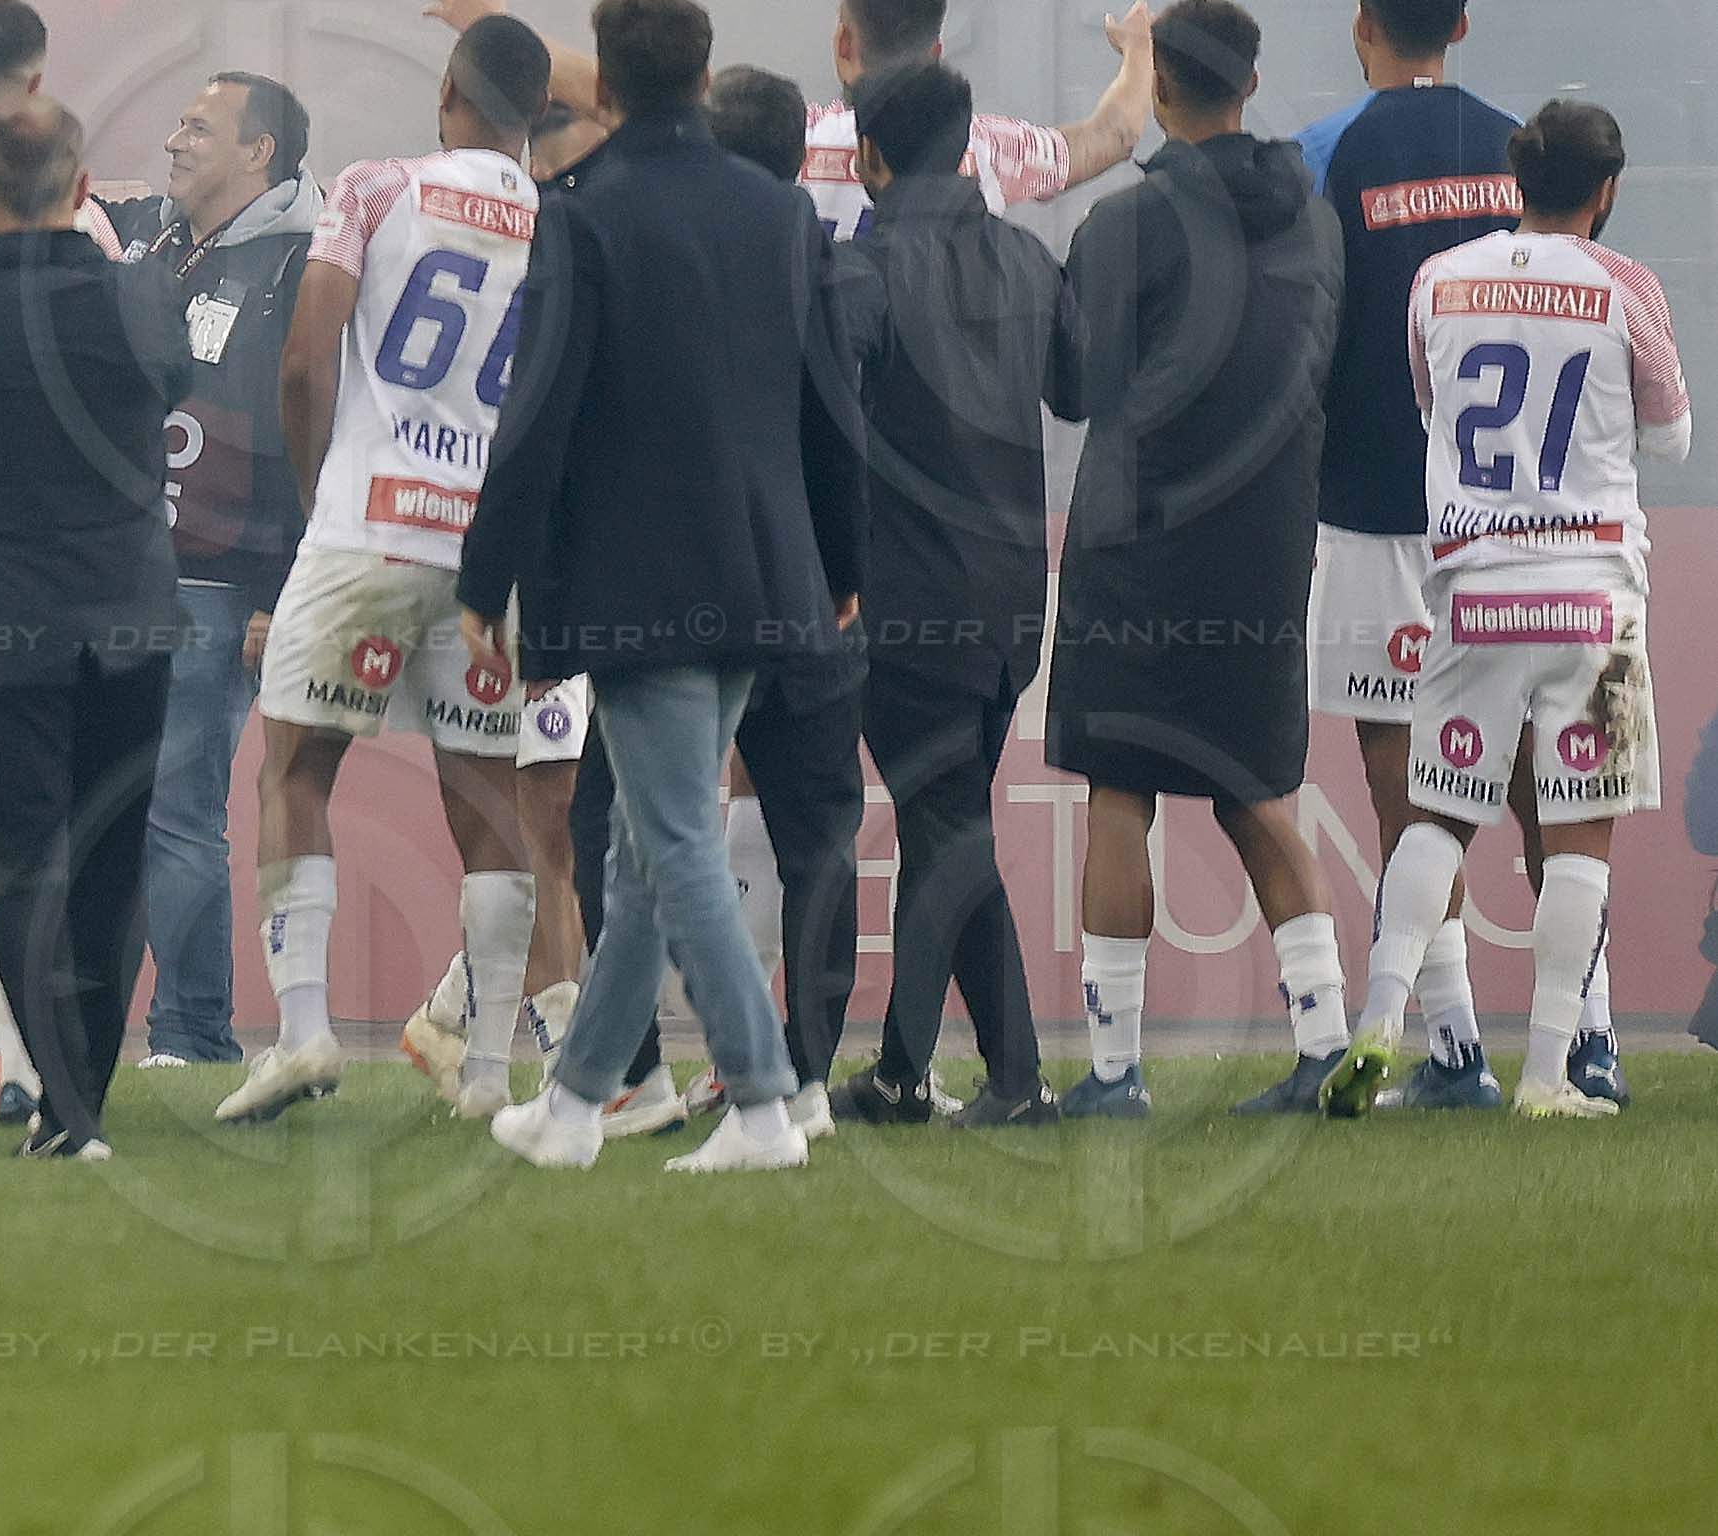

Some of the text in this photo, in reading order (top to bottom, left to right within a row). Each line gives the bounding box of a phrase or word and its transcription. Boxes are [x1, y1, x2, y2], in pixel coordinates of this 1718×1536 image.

[1409, 178, 1524, 216] GENERAL
[1472, 282, 1606, 320] GENERALI
[392, 411, 486, 470] MARTI
[1454, 343, 1592, 492] 21
